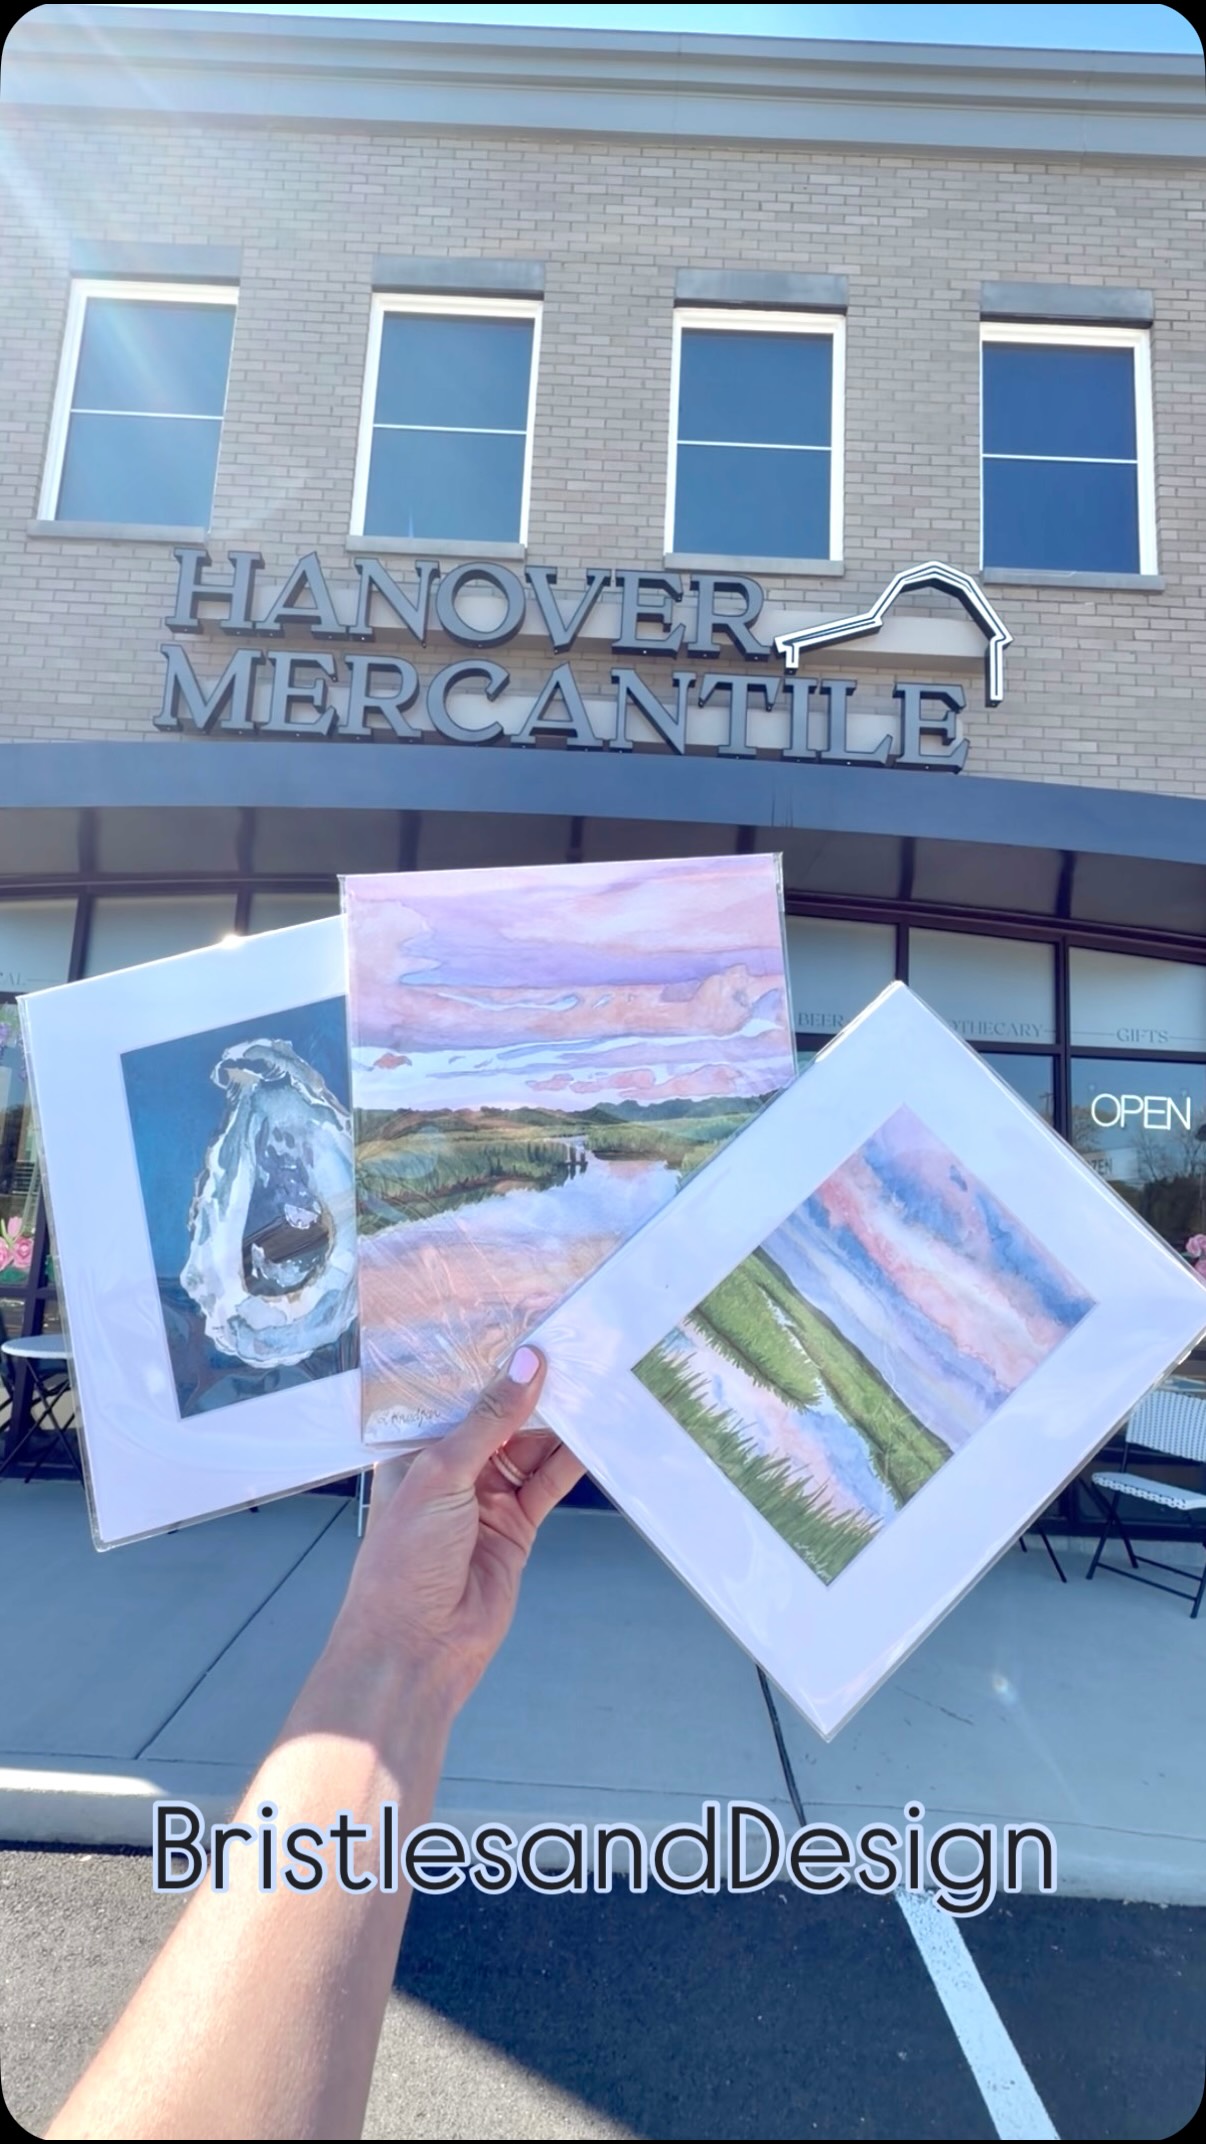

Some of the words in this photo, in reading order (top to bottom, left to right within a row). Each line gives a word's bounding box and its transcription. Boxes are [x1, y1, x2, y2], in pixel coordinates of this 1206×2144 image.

[164, 547, 772, 660] HANOVER
[153, 643, 970, 774] MERCANTILE
[798, 1011, 844, 1028] BEER
[1116, 1027, 1169, 1044] GIFTS
[1091, 1093, 1191, 1131] OPEN
